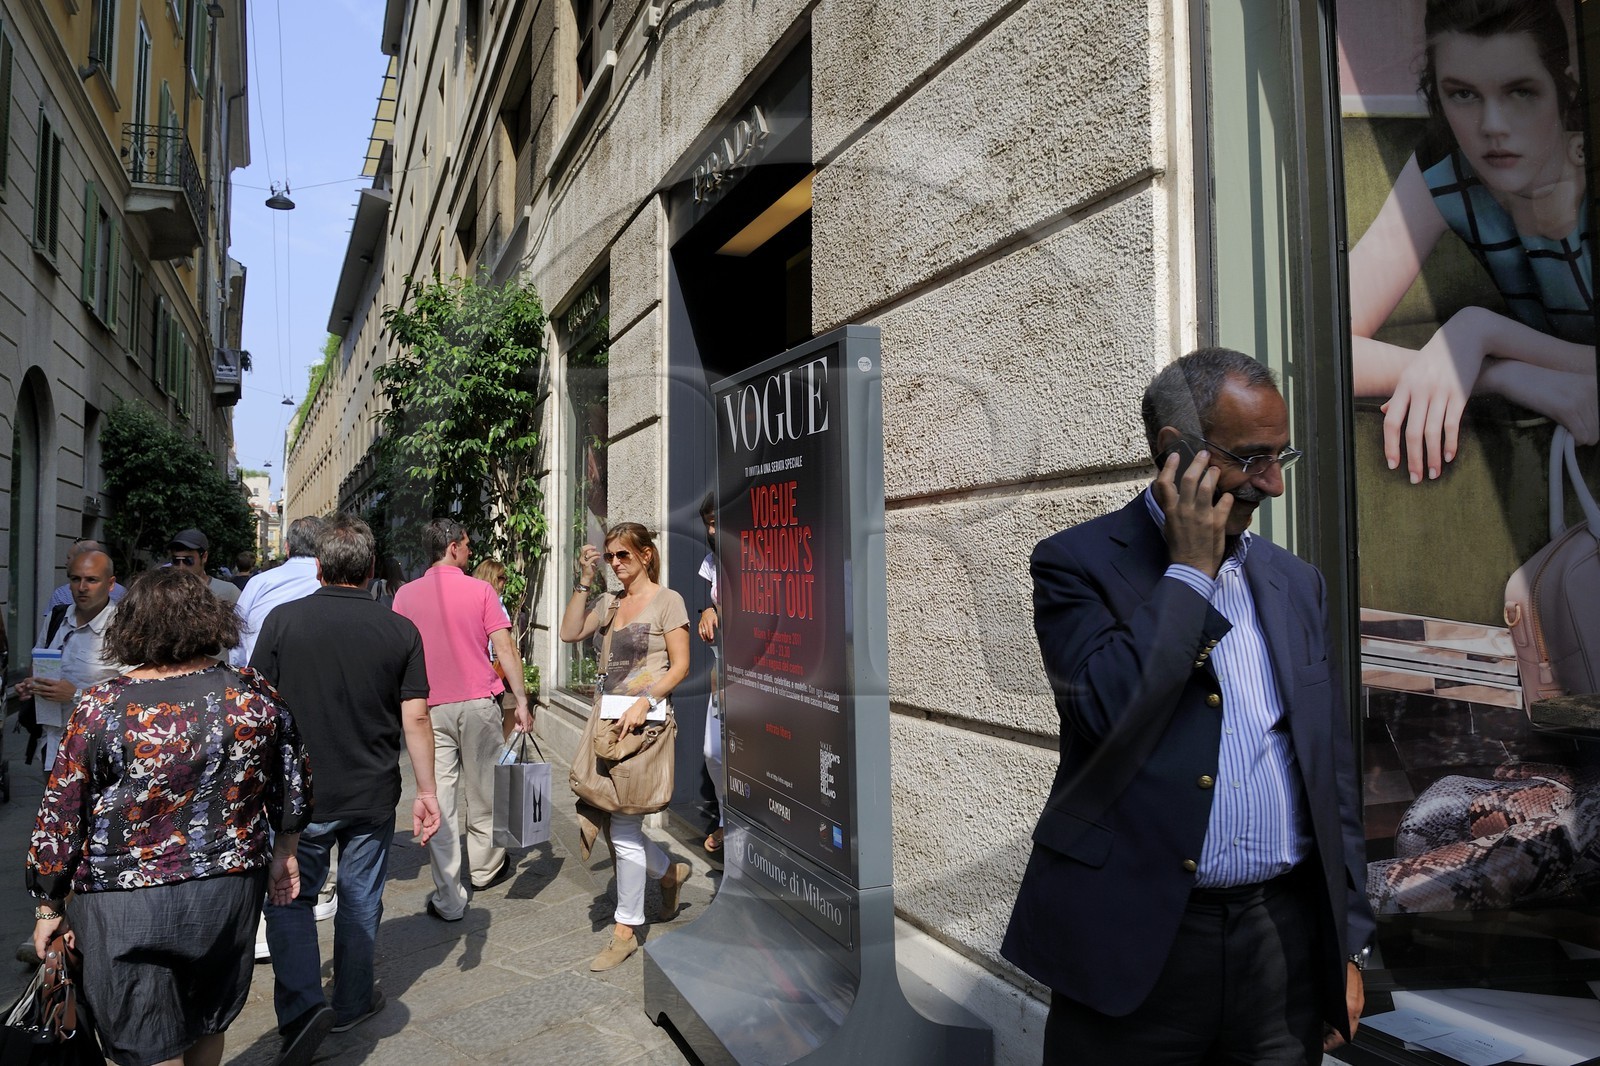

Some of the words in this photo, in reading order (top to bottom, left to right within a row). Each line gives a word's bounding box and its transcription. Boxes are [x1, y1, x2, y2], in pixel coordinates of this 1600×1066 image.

[693, 105, 770, 204] PRADA
[723, 356, 829, 453] VOGUE
[785, 455, 803, 470] SPECIALE
[750, 481, 798, 528] VOGUE
[740, 525, 813, 572] FASHION'S
[741, 572, 782, 616] NIGHT
[785, 573, 815, 620] OUT
[729, 775, 745, 797] LANCIA
[768, 797, 791, 821] CAMPARI
[747, 842, 787, 887] Comune
[789, 871, 800, 897] di
[802, 877, 842, 926] Milano
